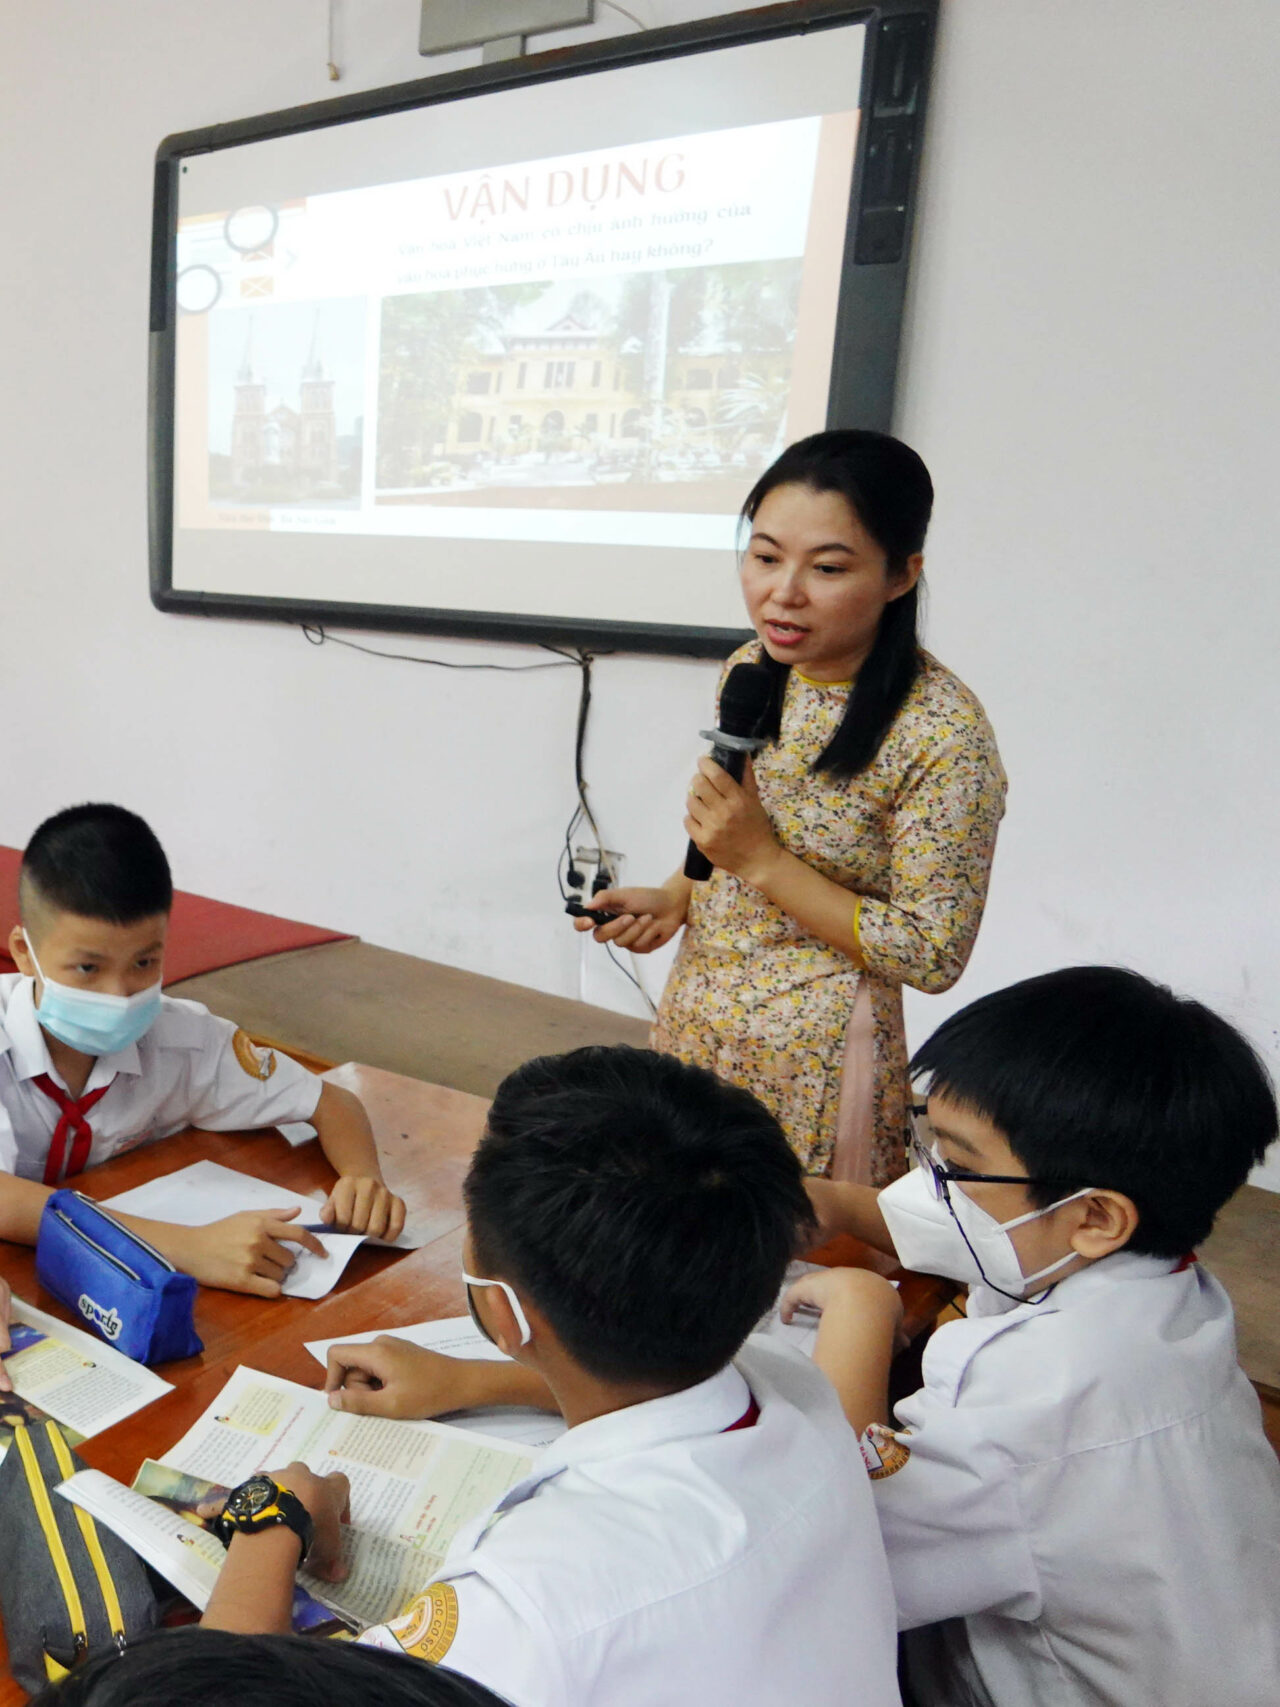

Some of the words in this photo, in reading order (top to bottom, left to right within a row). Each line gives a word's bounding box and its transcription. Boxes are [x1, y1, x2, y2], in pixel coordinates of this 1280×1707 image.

[443, 174, 531, 225] VẬN
[546, 153, 686, 211] DỤNG
[609, 247, 642, 264] hay
[646, 237, 714, 258] không?
[80, 1297, 118, 1336] sports
